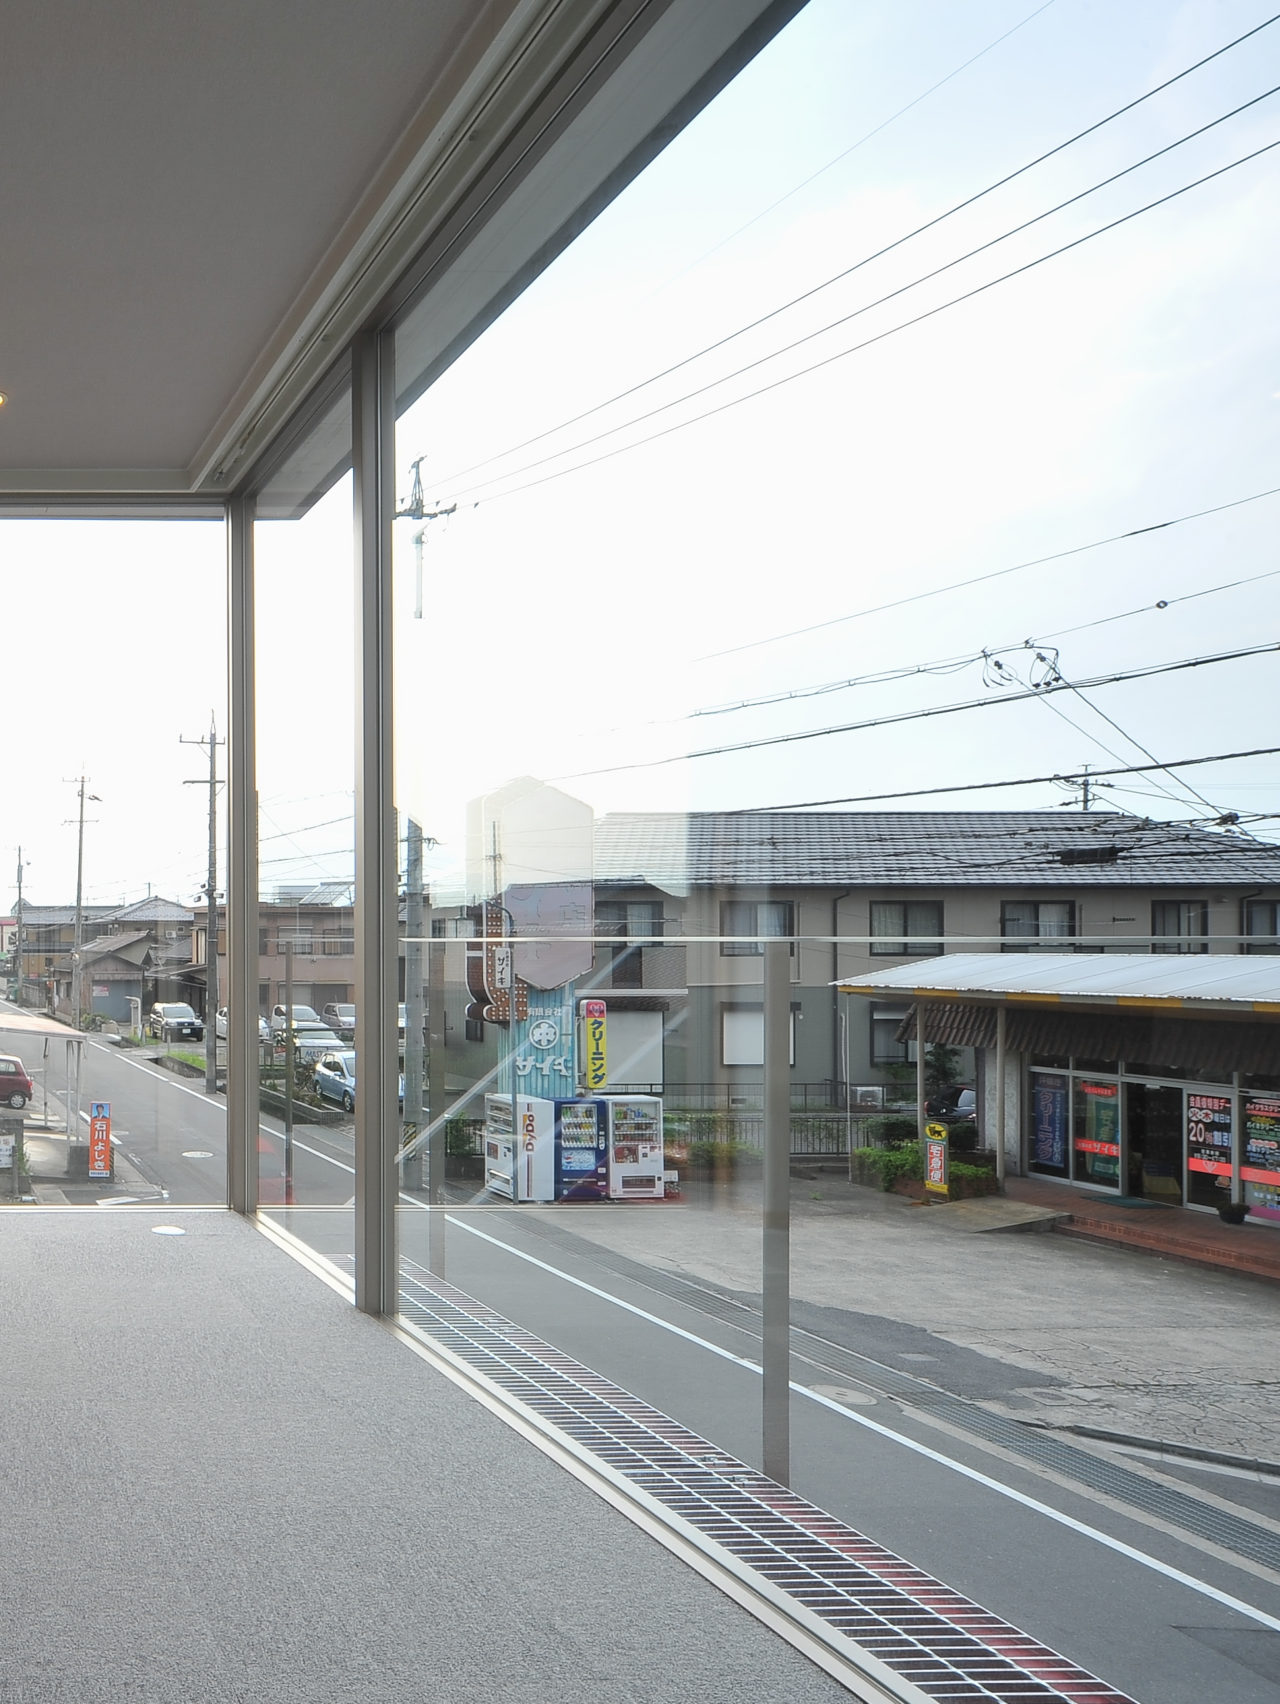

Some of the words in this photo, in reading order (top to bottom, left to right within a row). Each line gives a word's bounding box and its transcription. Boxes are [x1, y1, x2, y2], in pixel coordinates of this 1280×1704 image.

[591, 1019, 606, 1085] クリーニング
[525, 1113, 537, 1152] DyDo
